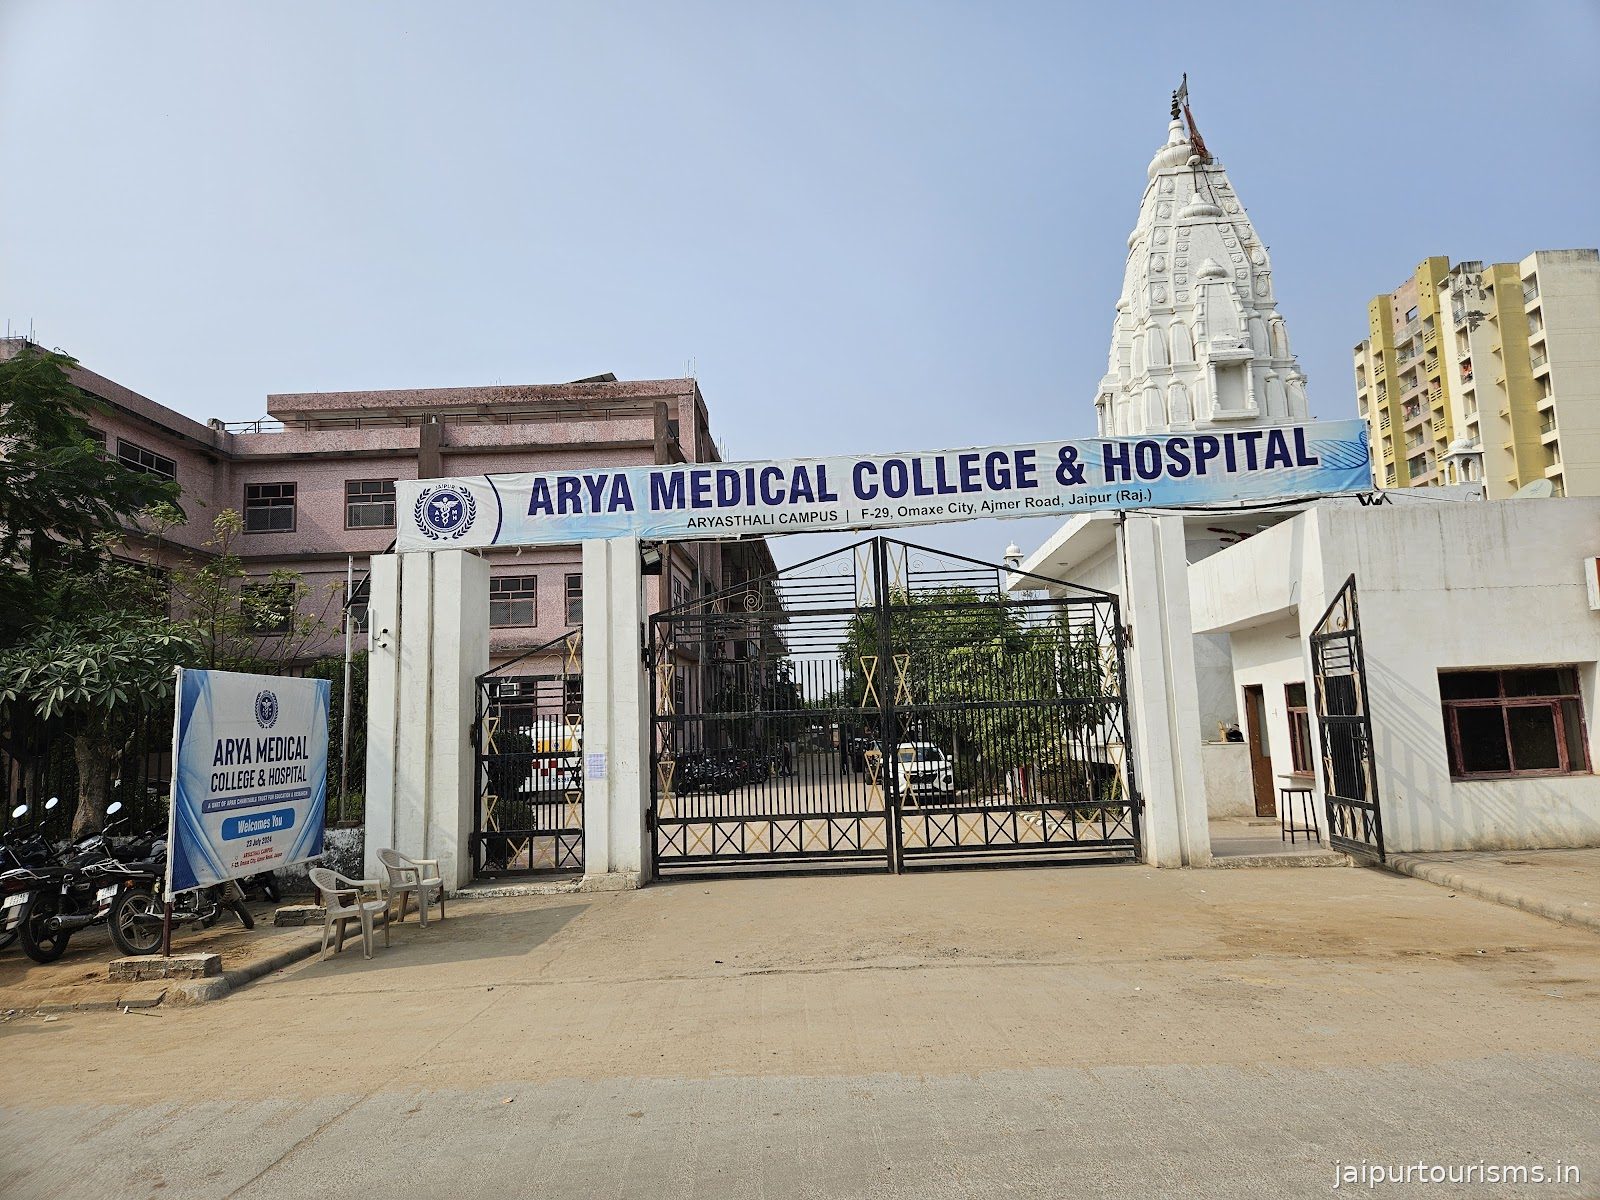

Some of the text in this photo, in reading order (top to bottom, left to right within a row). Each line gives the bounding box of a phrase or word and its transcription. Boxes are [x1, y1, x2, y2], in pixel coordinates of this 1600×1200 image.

[527, 427, 1319, 516] ARYA MEDICAL COLLEGE & HOSPITAL
[687, 488, 1152, 528] ARYASTHALI CAMPUS F-29, Omaxe City, Ajmer Road, Jaipur (Raj.)
[213, 735, 308, 766] ARYA MEDICAL
[210, 765, 307, 792] COLLEGE & HOSPITAL
[237, 814, 283, 834] Welcomes You
